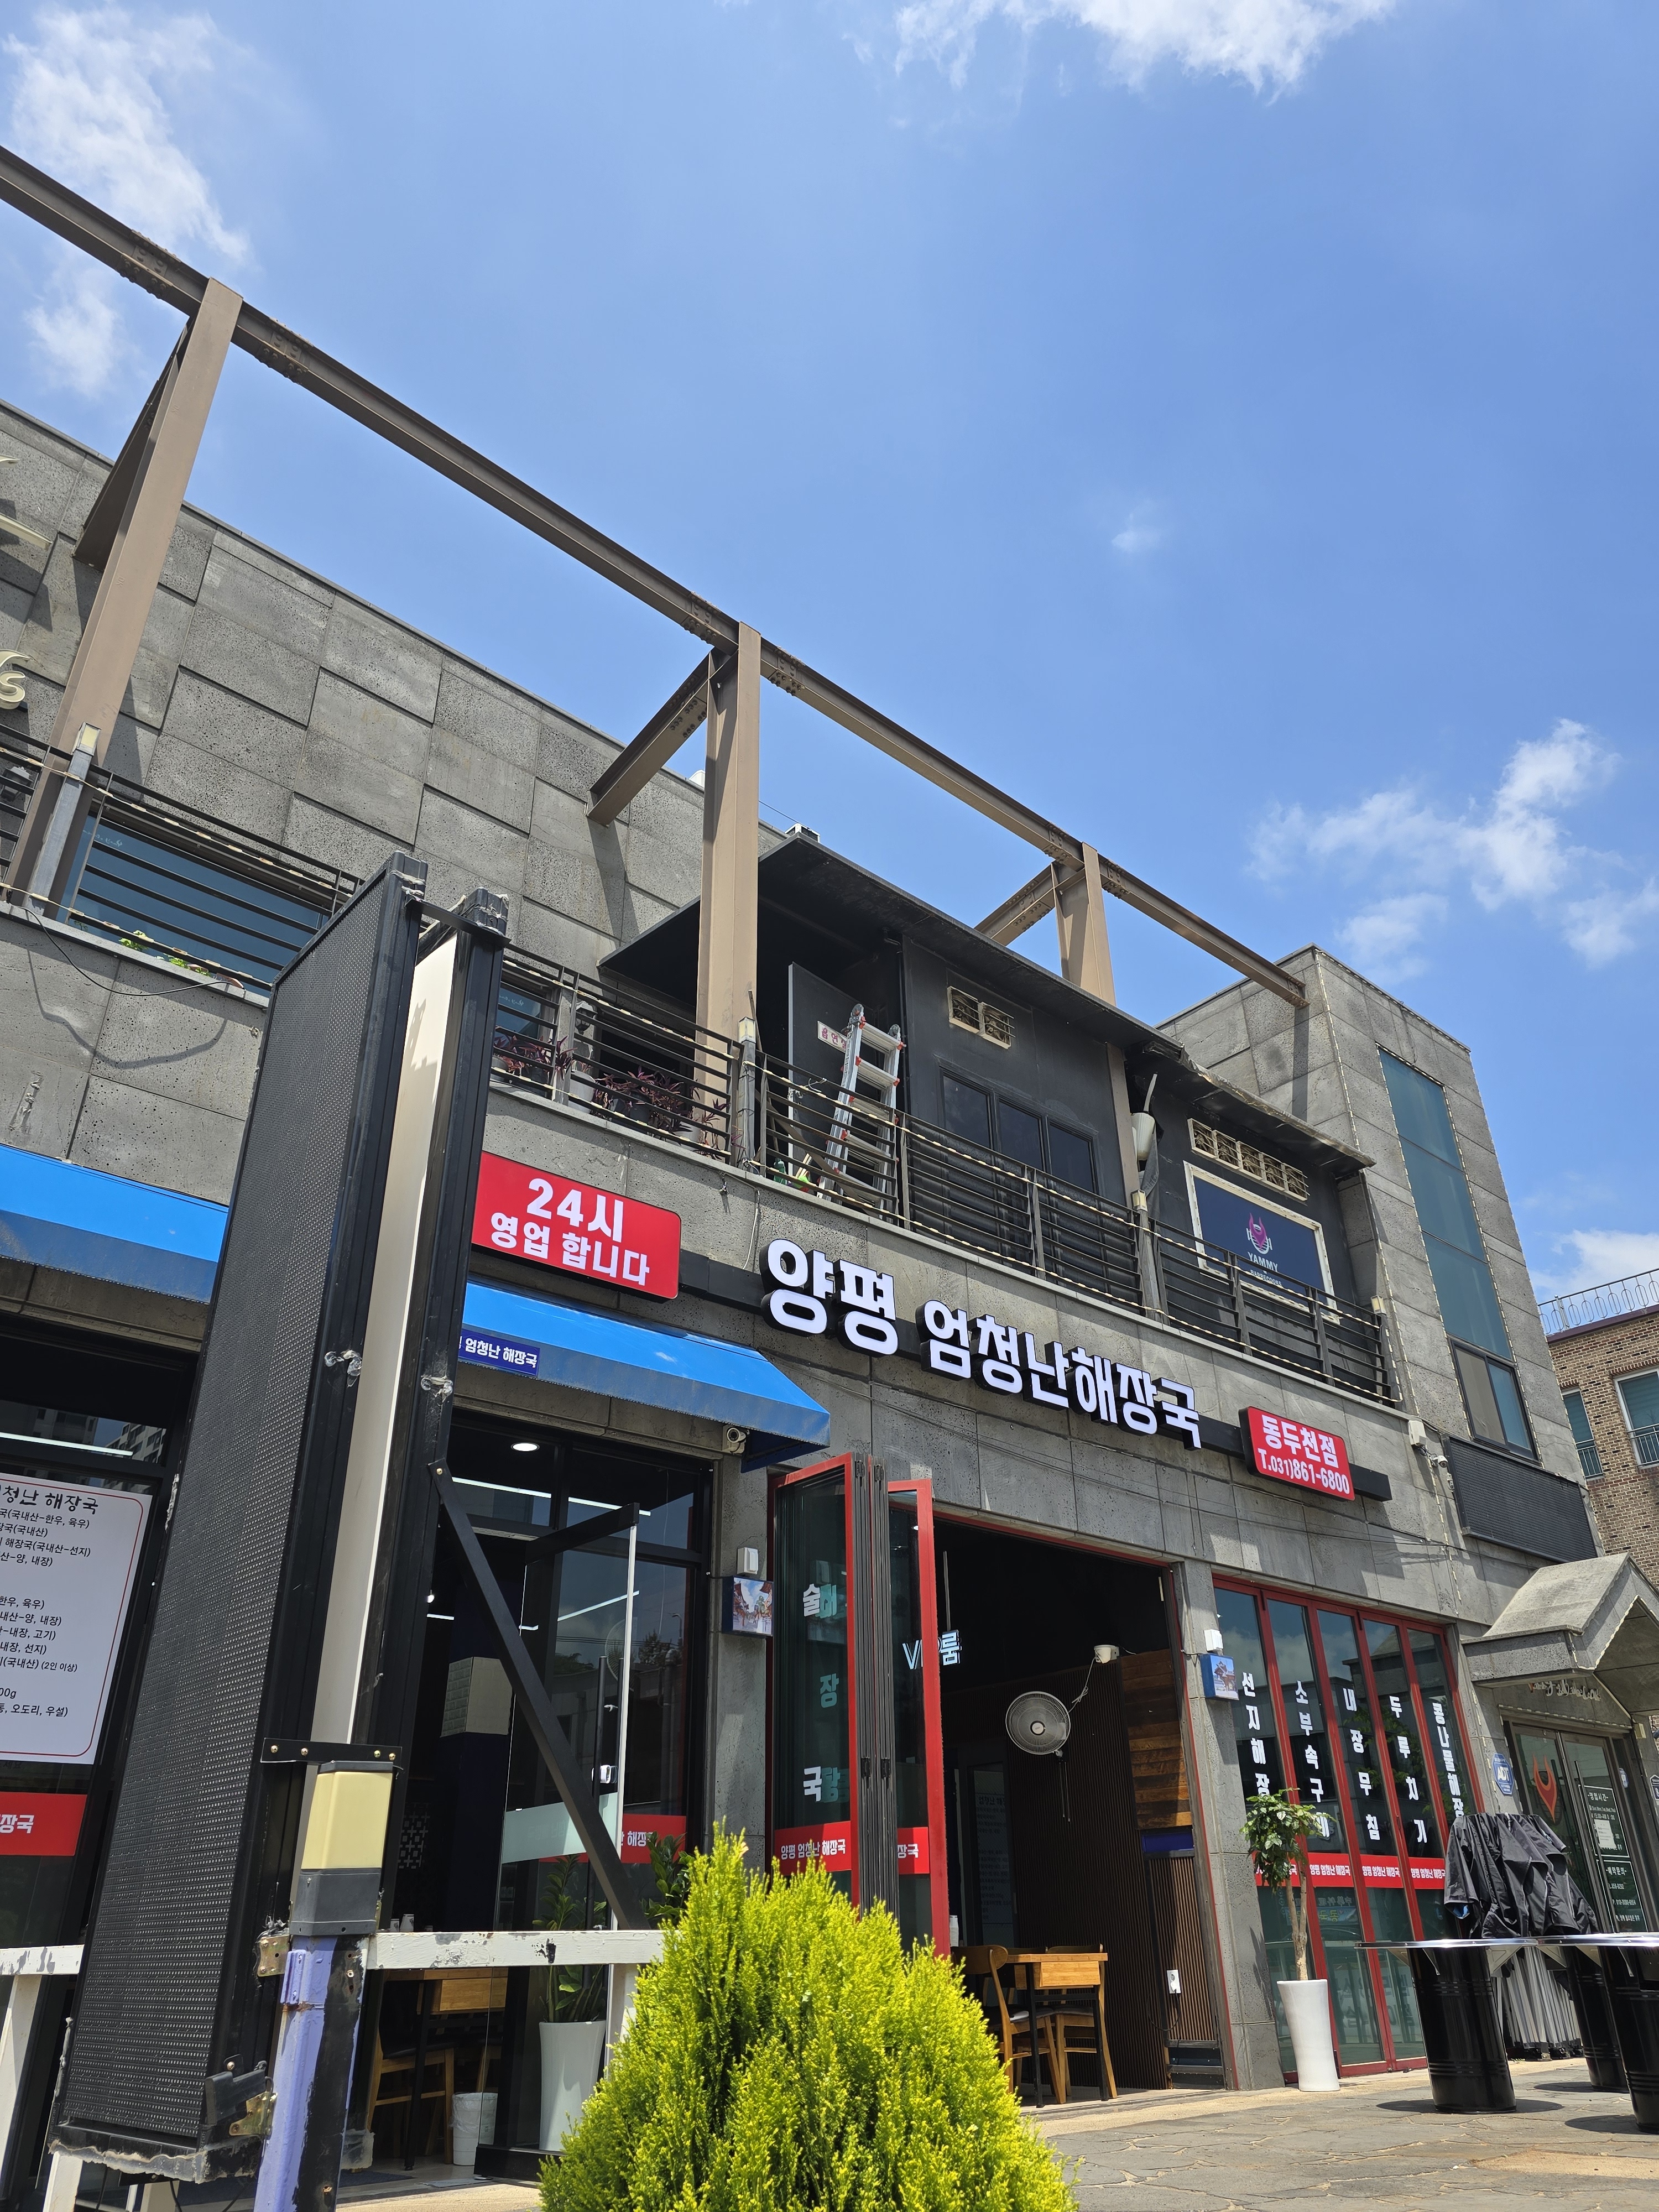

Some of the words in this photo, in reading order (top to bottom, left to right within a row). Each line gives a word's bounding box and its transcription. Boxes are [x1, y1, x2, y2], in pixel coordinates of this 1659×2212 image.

[526, 1178, 624, 1243] 24시
[491, 1212, 550, 1259] 영업
[562, 1232, 650, 1286] 합니다
[1248, 1251, 1278, 1272] YAMMY
[764, 1238, 899, 1355] 양평
[465, 1338, 501, 1359] 엄청난
[503, 1347, 538, 1368] 해장국
[1261, 1414, 1339, 1469] 동두천점
[1258, 1448, 1350, 1494] T.031)861-6800
[0, 1484, 39, 1506] 청난
[45, 1493, 98, 1515] 해장국
[68, 1517, 90, 1529] 육우)
[5, 1538, 91, 1558] 해장국(국내산-선지)
[32, 1556, 53, 1567] 내장)
[22, 1598, 45, 1610] 육우)
[40, 1615, 62, 1627] 내장)
[33, 1630, 56, 1641] 고기)
[24, 1644, 47, 1655] 선지)
[902, 1631, 961, 1670] VI룸
[0, 1656, 39, 1670] (국내산)
[41, 1661, 58, 1671] (2인
[59, 1663, 78, 1673] 이상)
[11, 1704, 43, 1717] 오도리,
[45, 1706, 69, 1718] 우설)
[1343, 1688, 1380, 1840] 내장무침
[1389, 1695, 1427, 1843] 두루치기
[1498, 1766, 1510, 1781] ADT
[0, 1814, 35, 1834] 장국
[627, 1830, 657, 1847] 해장
[781, 1845, 796, 1860] 양평
[822, 1839, 846, 1856] 해장국
[1310, 1864, 1320, 1876] 양평
[1321, 1864, 1335, 1876] 엄청난
[1335, 1864, 1351, 1876] 해장국
[1361, 1865, 1372, 1876] 양평
[1372, 1866, 1386, 1877] 엄청난
[1386, 1866, 1401, 1878] 해장국
[1410, 1867, 1420, 1879] 양평
[1420, 1868, 1434, 1879] 엄청난
[1433, 1869, 1447, 1879] 해장국
